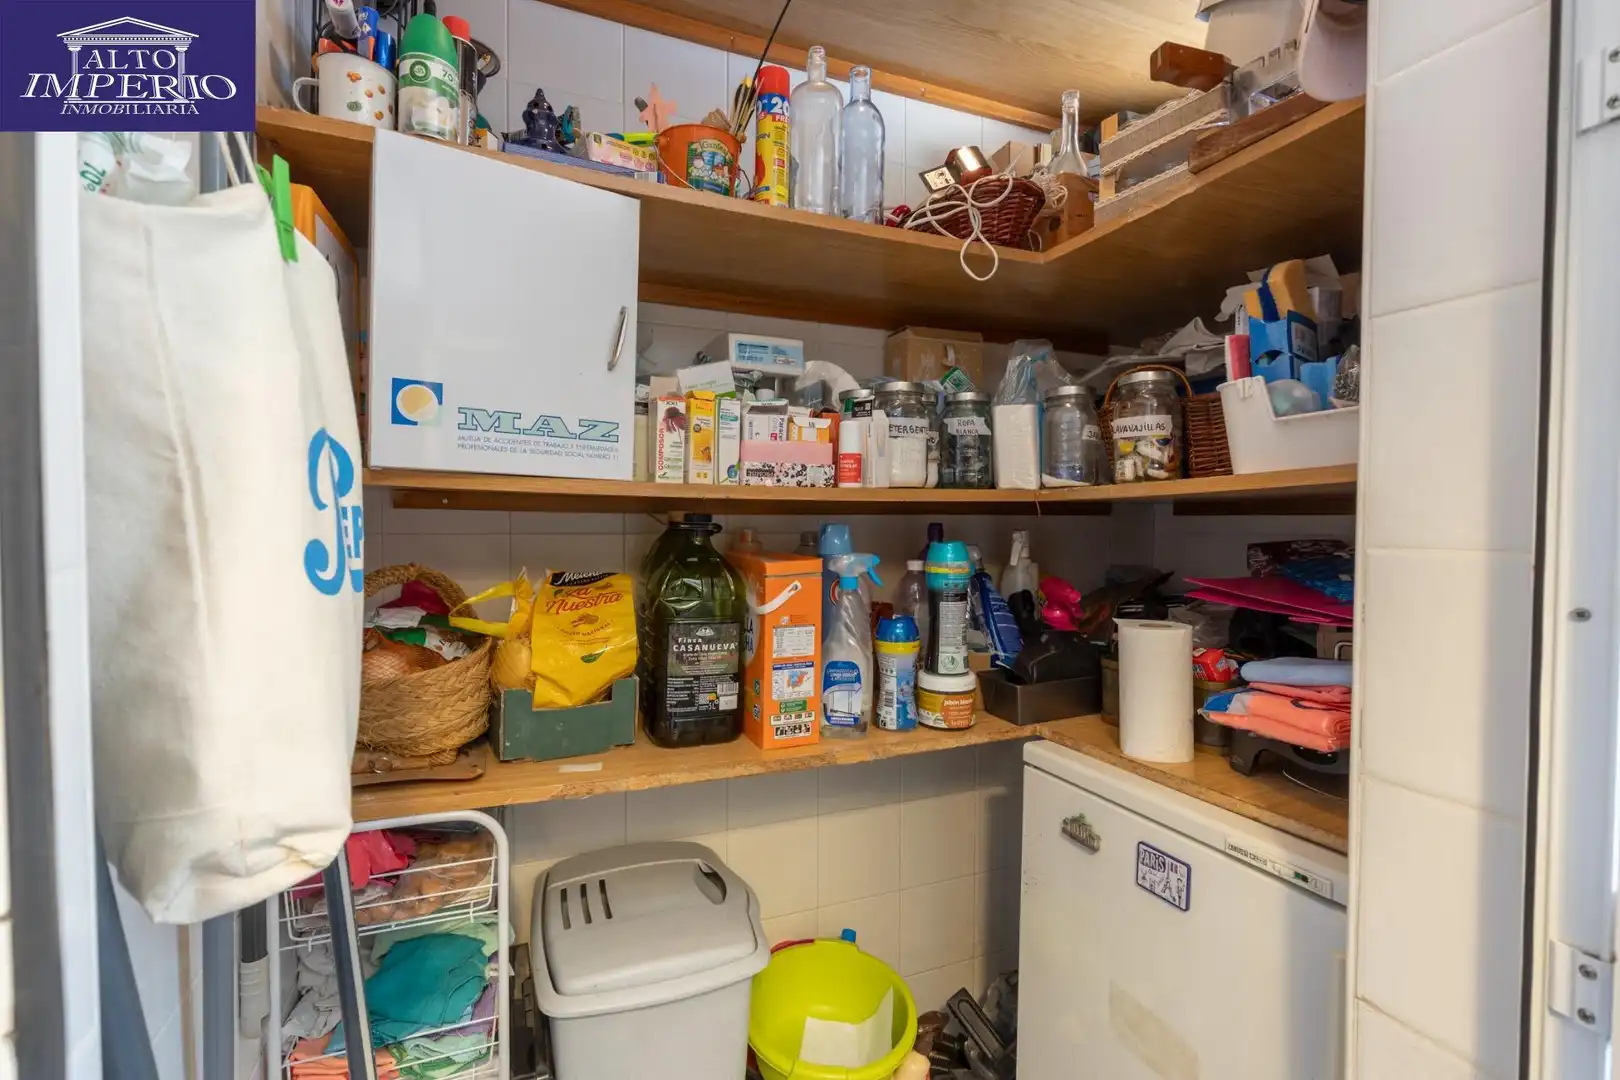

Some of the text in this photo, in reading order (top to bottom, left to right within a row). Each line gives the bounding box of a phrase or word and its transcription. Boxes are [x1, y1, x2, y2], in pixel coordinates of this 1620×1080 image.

[458, 407, 619, 443] MAZ
[546, 592, 624, 615] Nuestra
[673, 643, 736, 652] CASANUEVA
